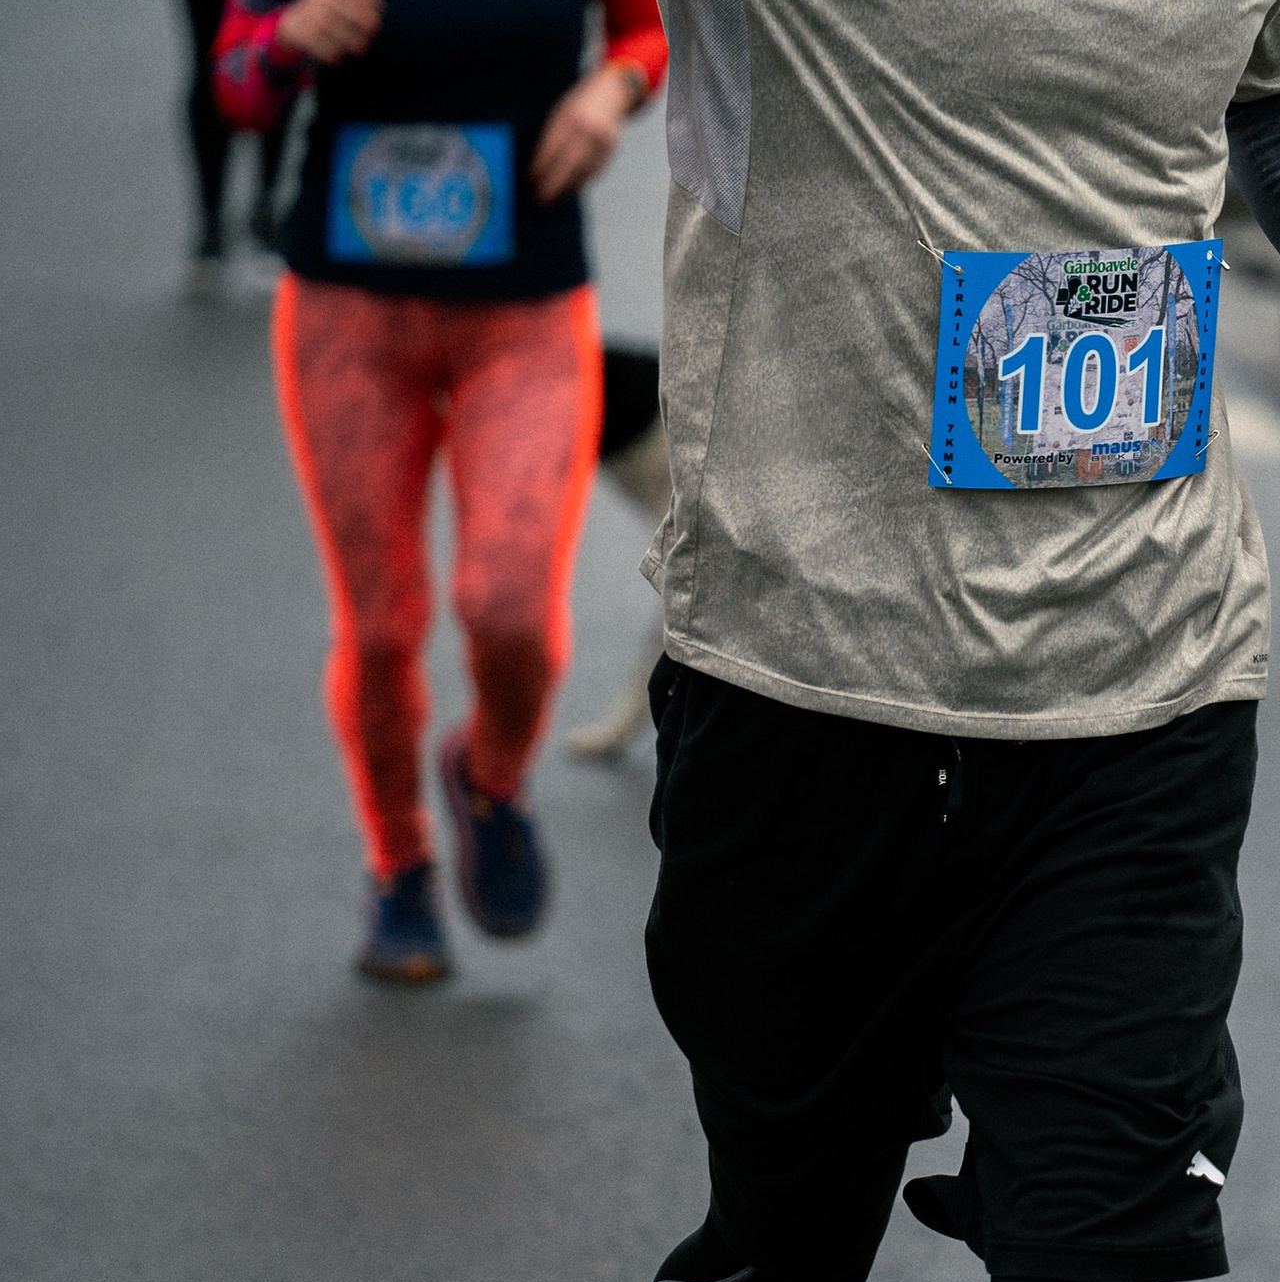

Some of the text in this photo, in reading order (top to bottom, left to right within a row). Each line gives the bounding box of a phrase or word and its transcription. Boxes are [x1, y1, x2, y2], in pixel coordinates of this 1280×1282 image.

[1063, 257, 1138, 275] Gârboavele
[1077, 285, 1091, 302] &
[1086, 272, 1138, 294] RUN
[1084, 293, 1137, 314] RIDE
[1203, 266, 1213, 333] TRAIL
[953, 279, 965, 346] TRAIL
[999, 326, 1166, 435] 101
[1199, 353, 1207, 390] RUN
[948, 366, 959, 404] RUN
[1091, 453, 1140, 462] BIKE
[1092, 440, 1141, 456] maus
[994, 452, 1074, 466] Powered by
